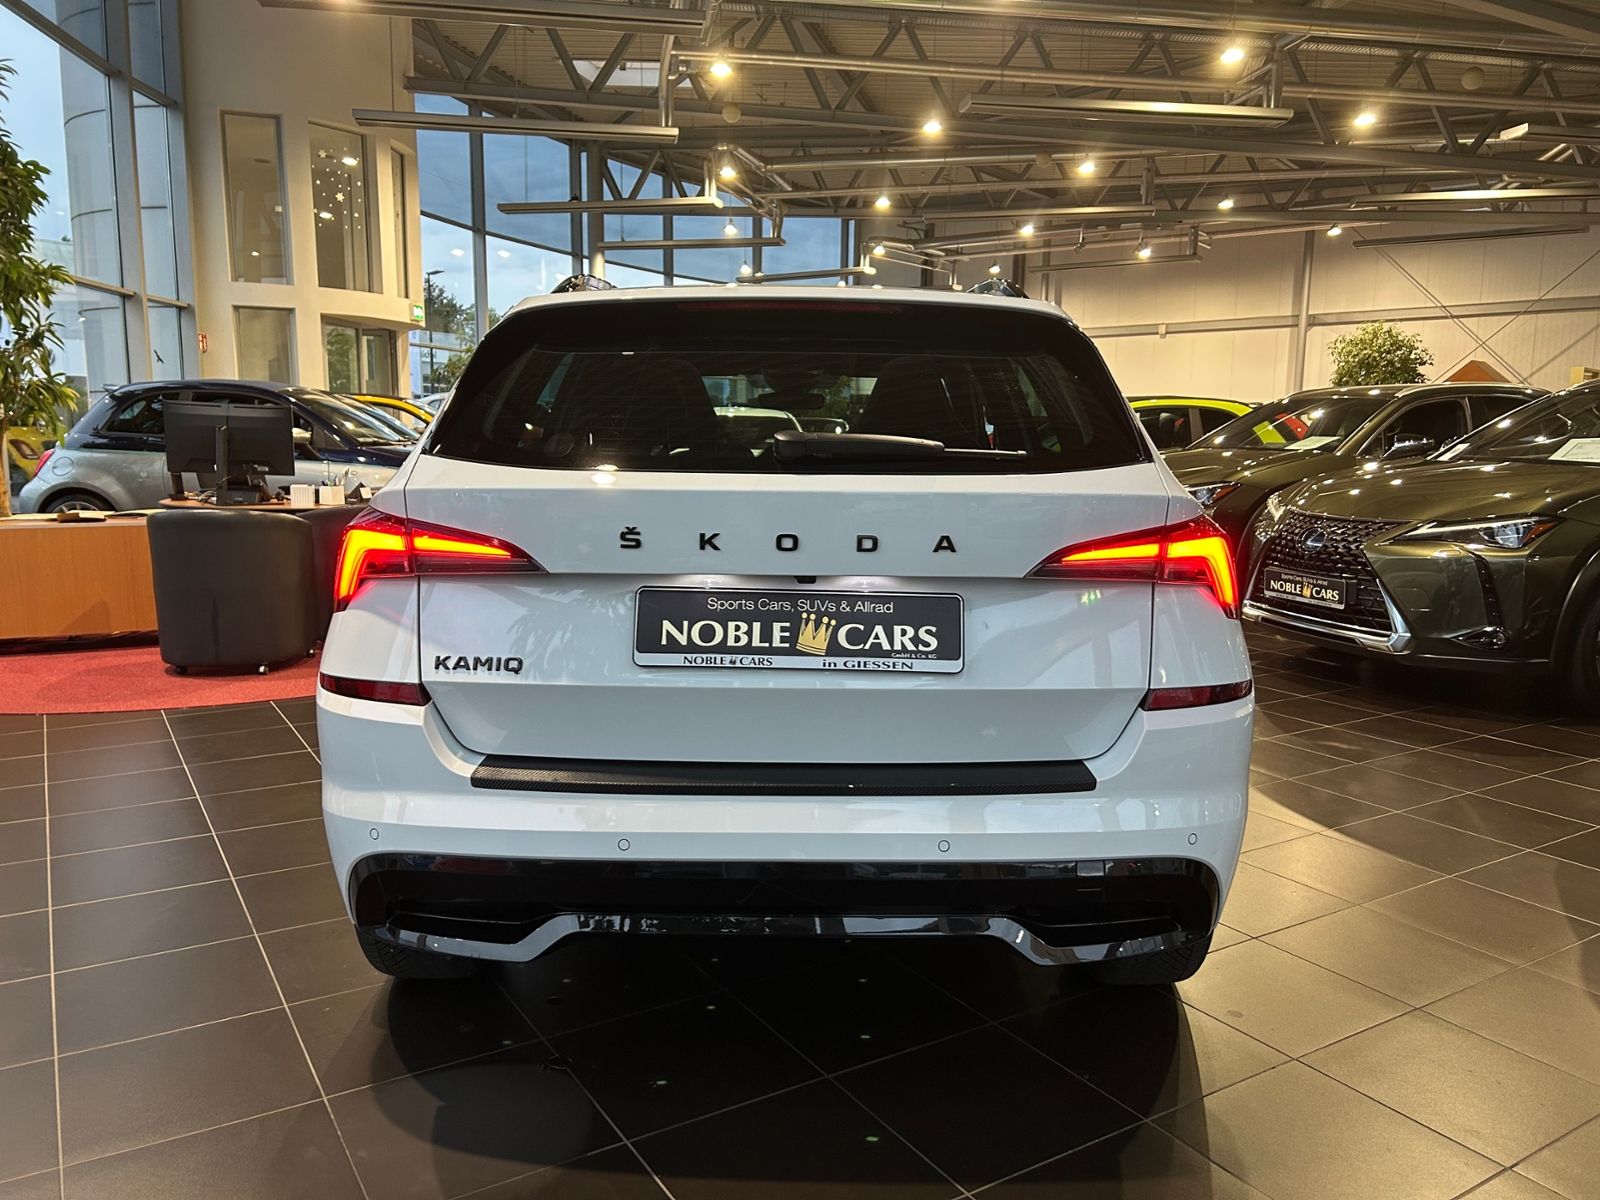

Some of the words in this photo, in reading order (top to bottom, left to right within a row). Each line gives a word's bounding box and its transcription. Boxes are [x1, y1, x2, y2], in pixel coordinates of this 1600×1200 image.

[619, 526, 957, 553] ŠKODA
[1270, 579, 1302, 595] NOBLE
[1312, 587, 1339, 601] CARS
[707, 597, 755, 612] Sports
[757, 598, 795, 613] Cars,
[797, 599, 837, 612] SUVs
[839, 601, 851, 612] &
[853, 601, 894, 613] Allrad
[660, 619, 791, 648] NOBLE
[836, 623, 938, 652] CARS
[434, 655, 524, 675] KAMIQ
[683, 655, 727, 665] NOBLE
[739, 656, 773, 667] CARS
[822, 659, 838, 668] in
[843, 660, 914, 670] GIESSEN
